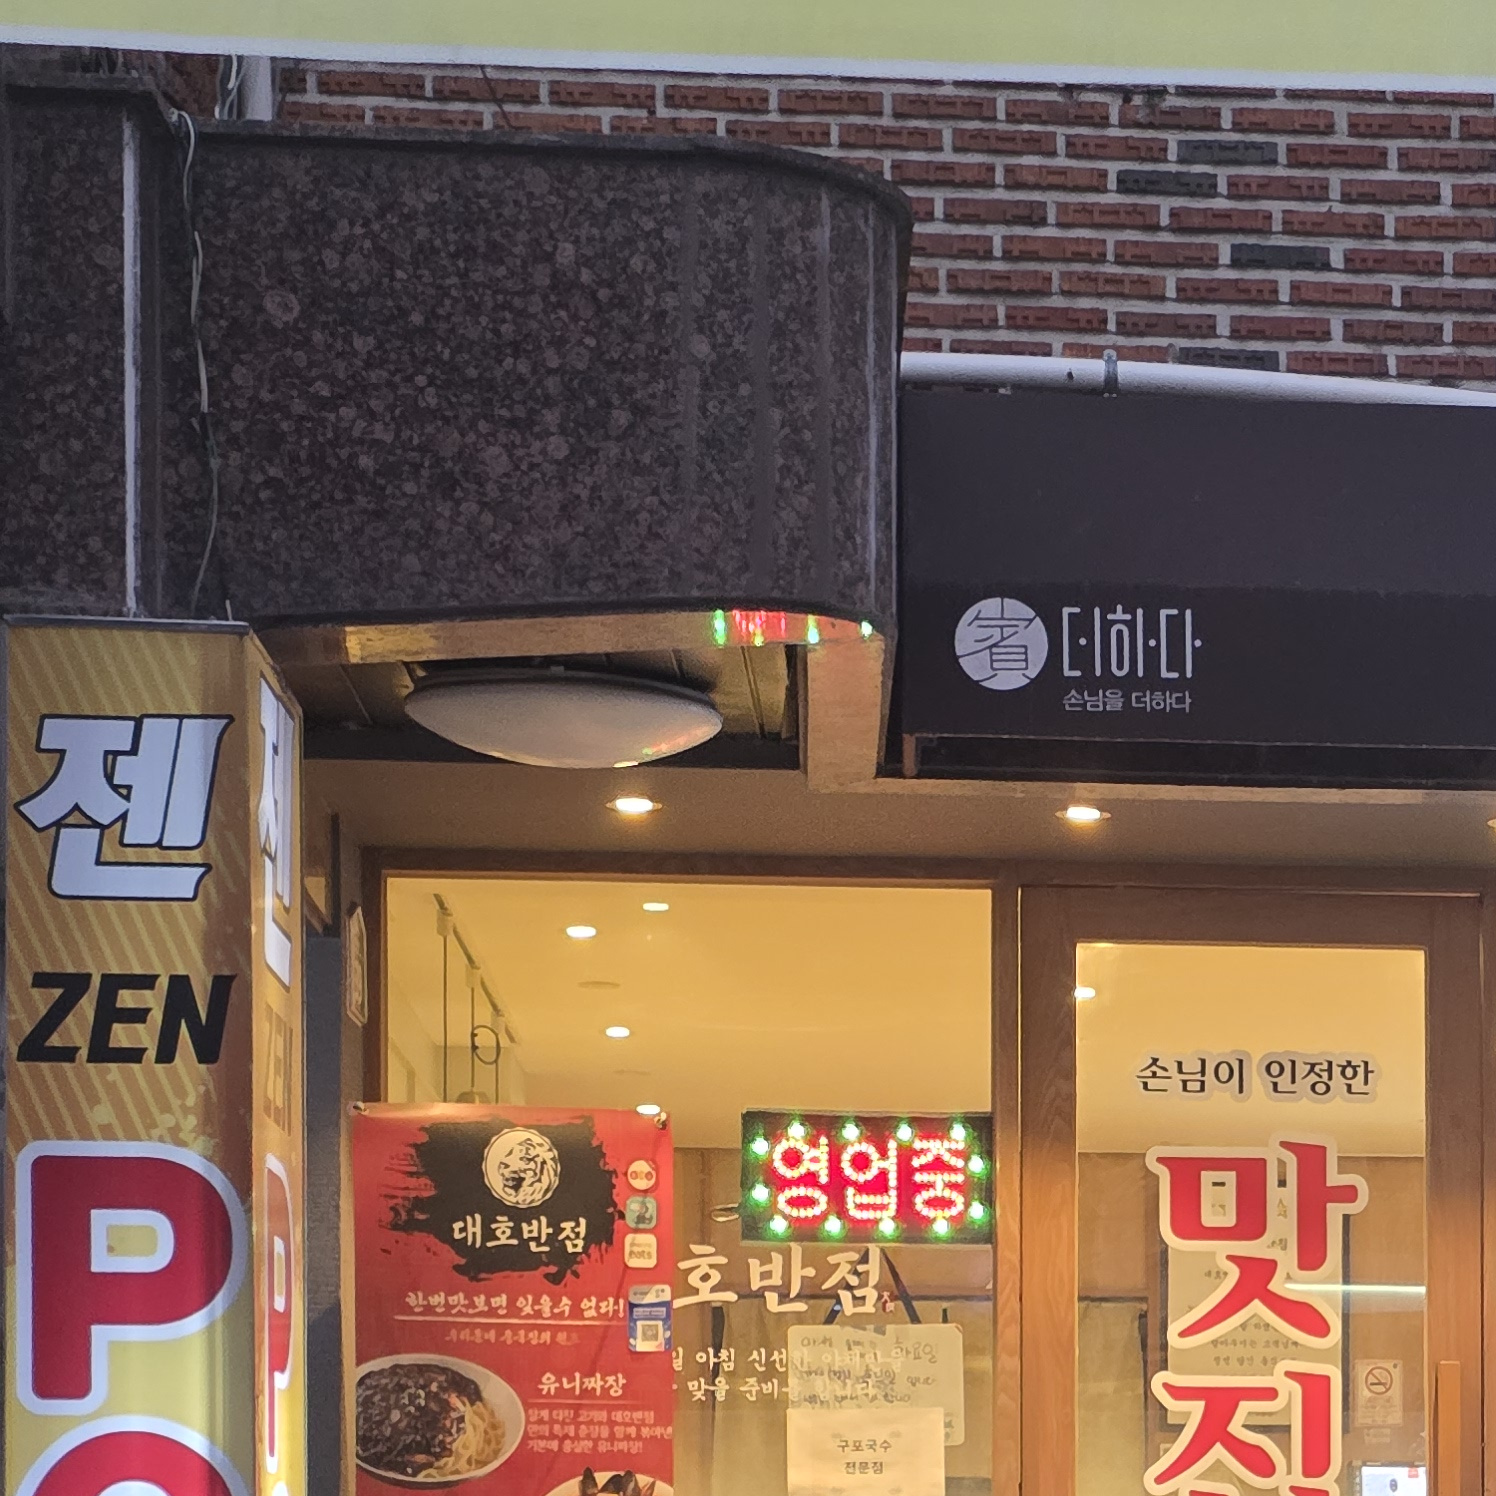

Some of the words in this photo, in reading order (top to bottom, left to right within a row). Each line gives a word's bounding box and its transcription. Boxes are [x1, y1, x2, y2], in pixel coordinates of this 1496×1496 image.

[1062, 604, 1202, 678] 더하다
[1062, 689, 1125, 712] 손님을
[1131, 690, 1192, 713] 더하다
[10, 714, 235, 900] 젠
[16, 972, 238, 1064] ZEN
[1135, 1056, 1245, 1095] 손님이
[1264, 1058, 1375, 1096] 인정한
[772, 1135, 966, 1221] 영업중
[452, 1213, 588, 1254] 대호반점
[673, 1242, 882, 1317] 호반점
[696, 1348, 736, 1371] 아침
[537, 1371, 627, 1397] 유니짜장
[836, 1439, 893, 1453] 구포국수
[844, 1461, 885, 1475] 전문점
